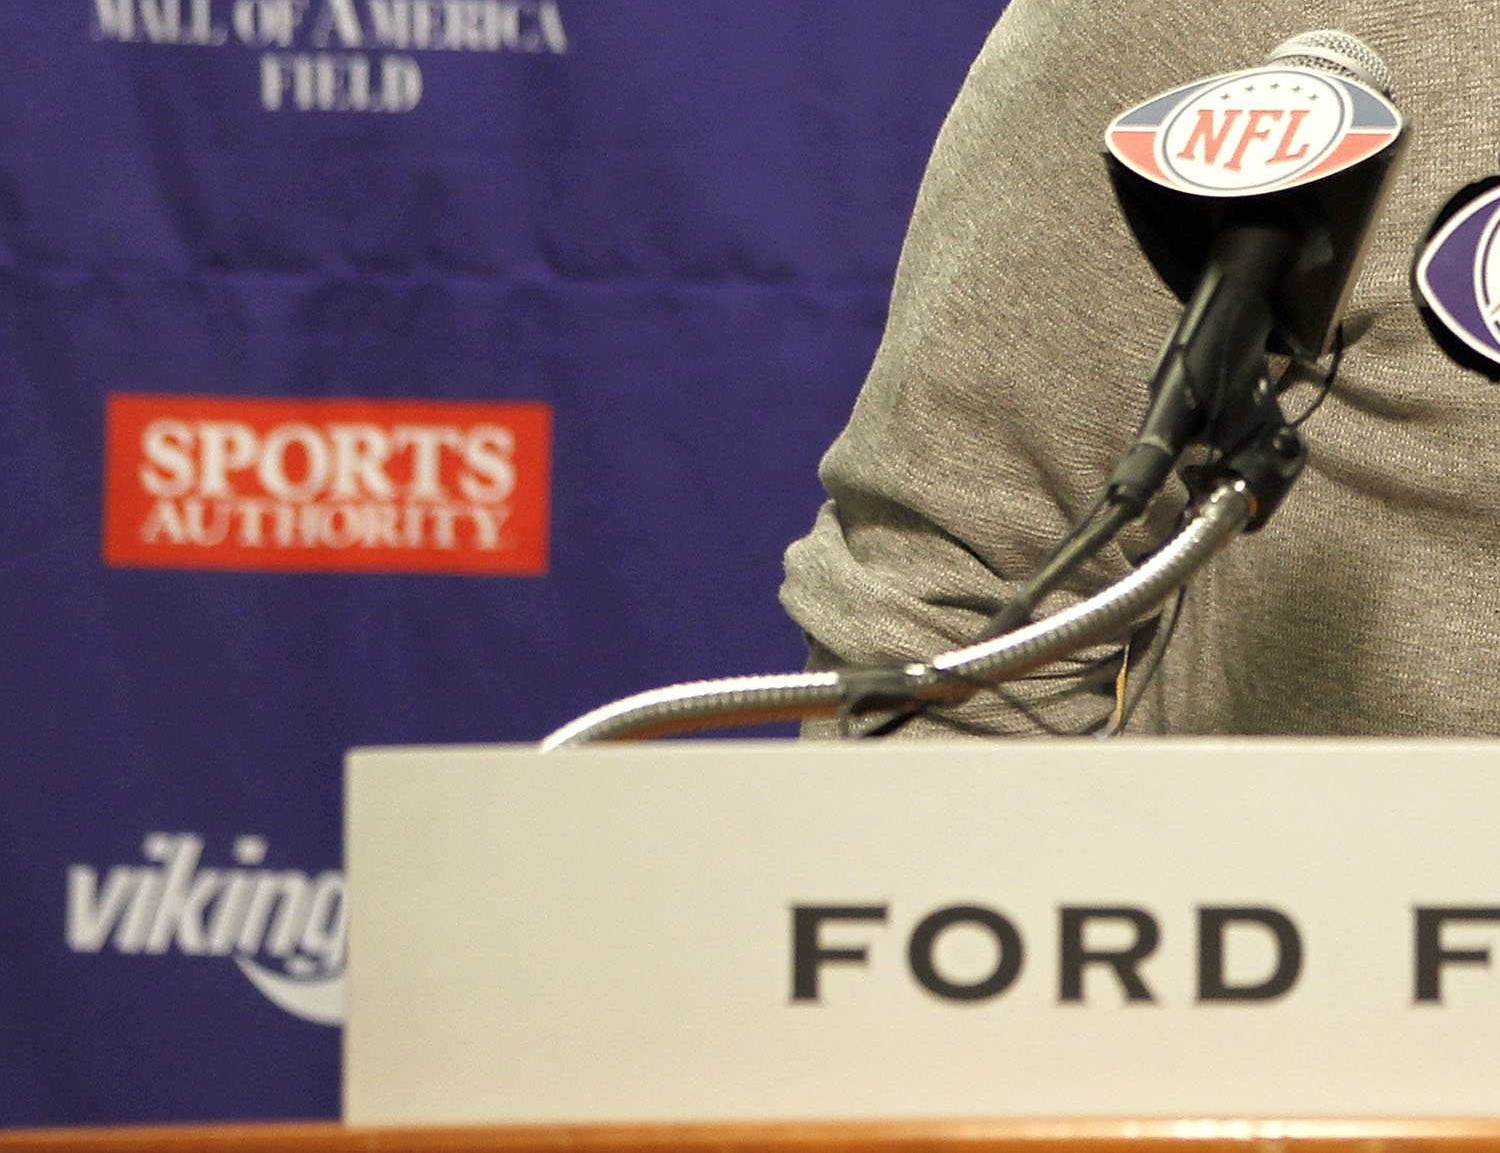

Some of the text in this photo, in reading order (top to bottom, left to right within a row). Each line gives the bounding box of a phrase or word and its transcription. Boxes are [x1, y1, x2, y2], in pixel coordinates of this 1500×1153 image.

[260, 51, 424, 114] FIELD
[1175, 107, 1310, 173] NFL
[140, 417, 517, 505] SPORTS
[142, 497, 512, 551] AUTHORITY
[65, 832, 346, 977] viking
[788, 901, 1304, 1006] FORD
